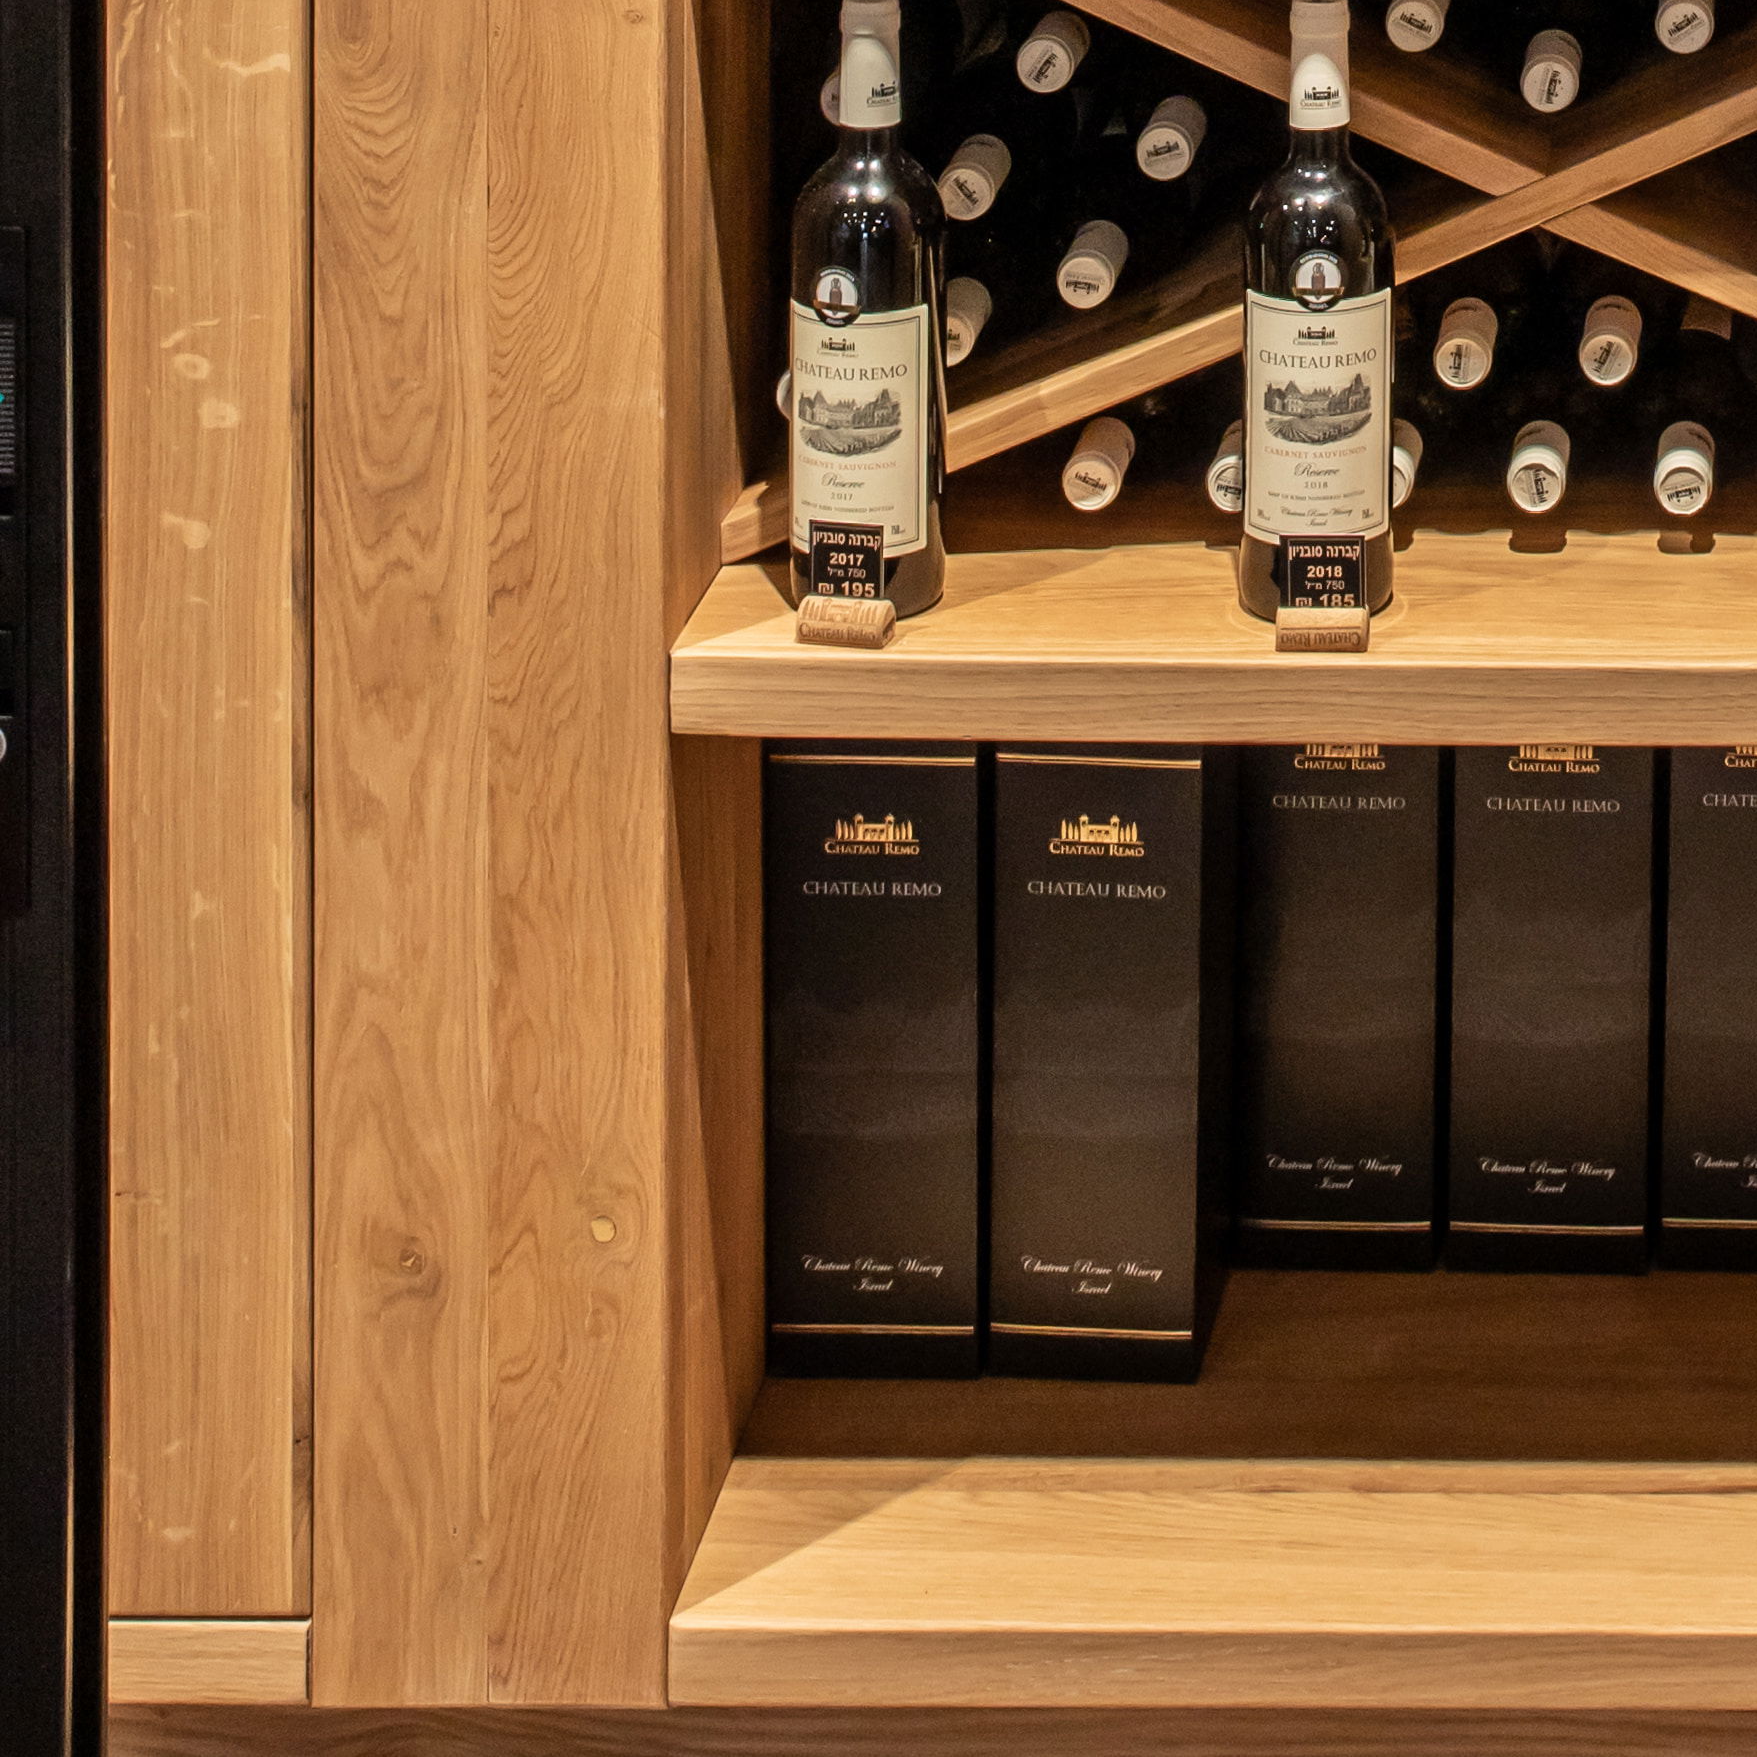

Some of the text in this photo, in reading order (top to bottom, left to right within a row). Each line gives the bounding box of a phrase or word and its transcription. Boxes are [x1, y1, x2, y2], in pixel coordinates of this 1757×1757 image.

[1259, 348, 1377, 369] CHATEAU REMO
[795, 358, 908, 381] CHATEAU REMO
[1264, 443, 1307, 459] CABERNET
[829, 552, 865, 566] 2017
[1307, 566, 1342, 578] 2018
[841, 581, 875, 597] 195
[1319, 593, 1355, 607] 185
[1486, 797, 1621, 814] CHATEAU REMO
[824, 841, 920, 856] CHATEAU REMO
[803, 881, 942, 898] CHATEAU REMO
[1027, 880, 1166, 899] CHATEAU REMO
